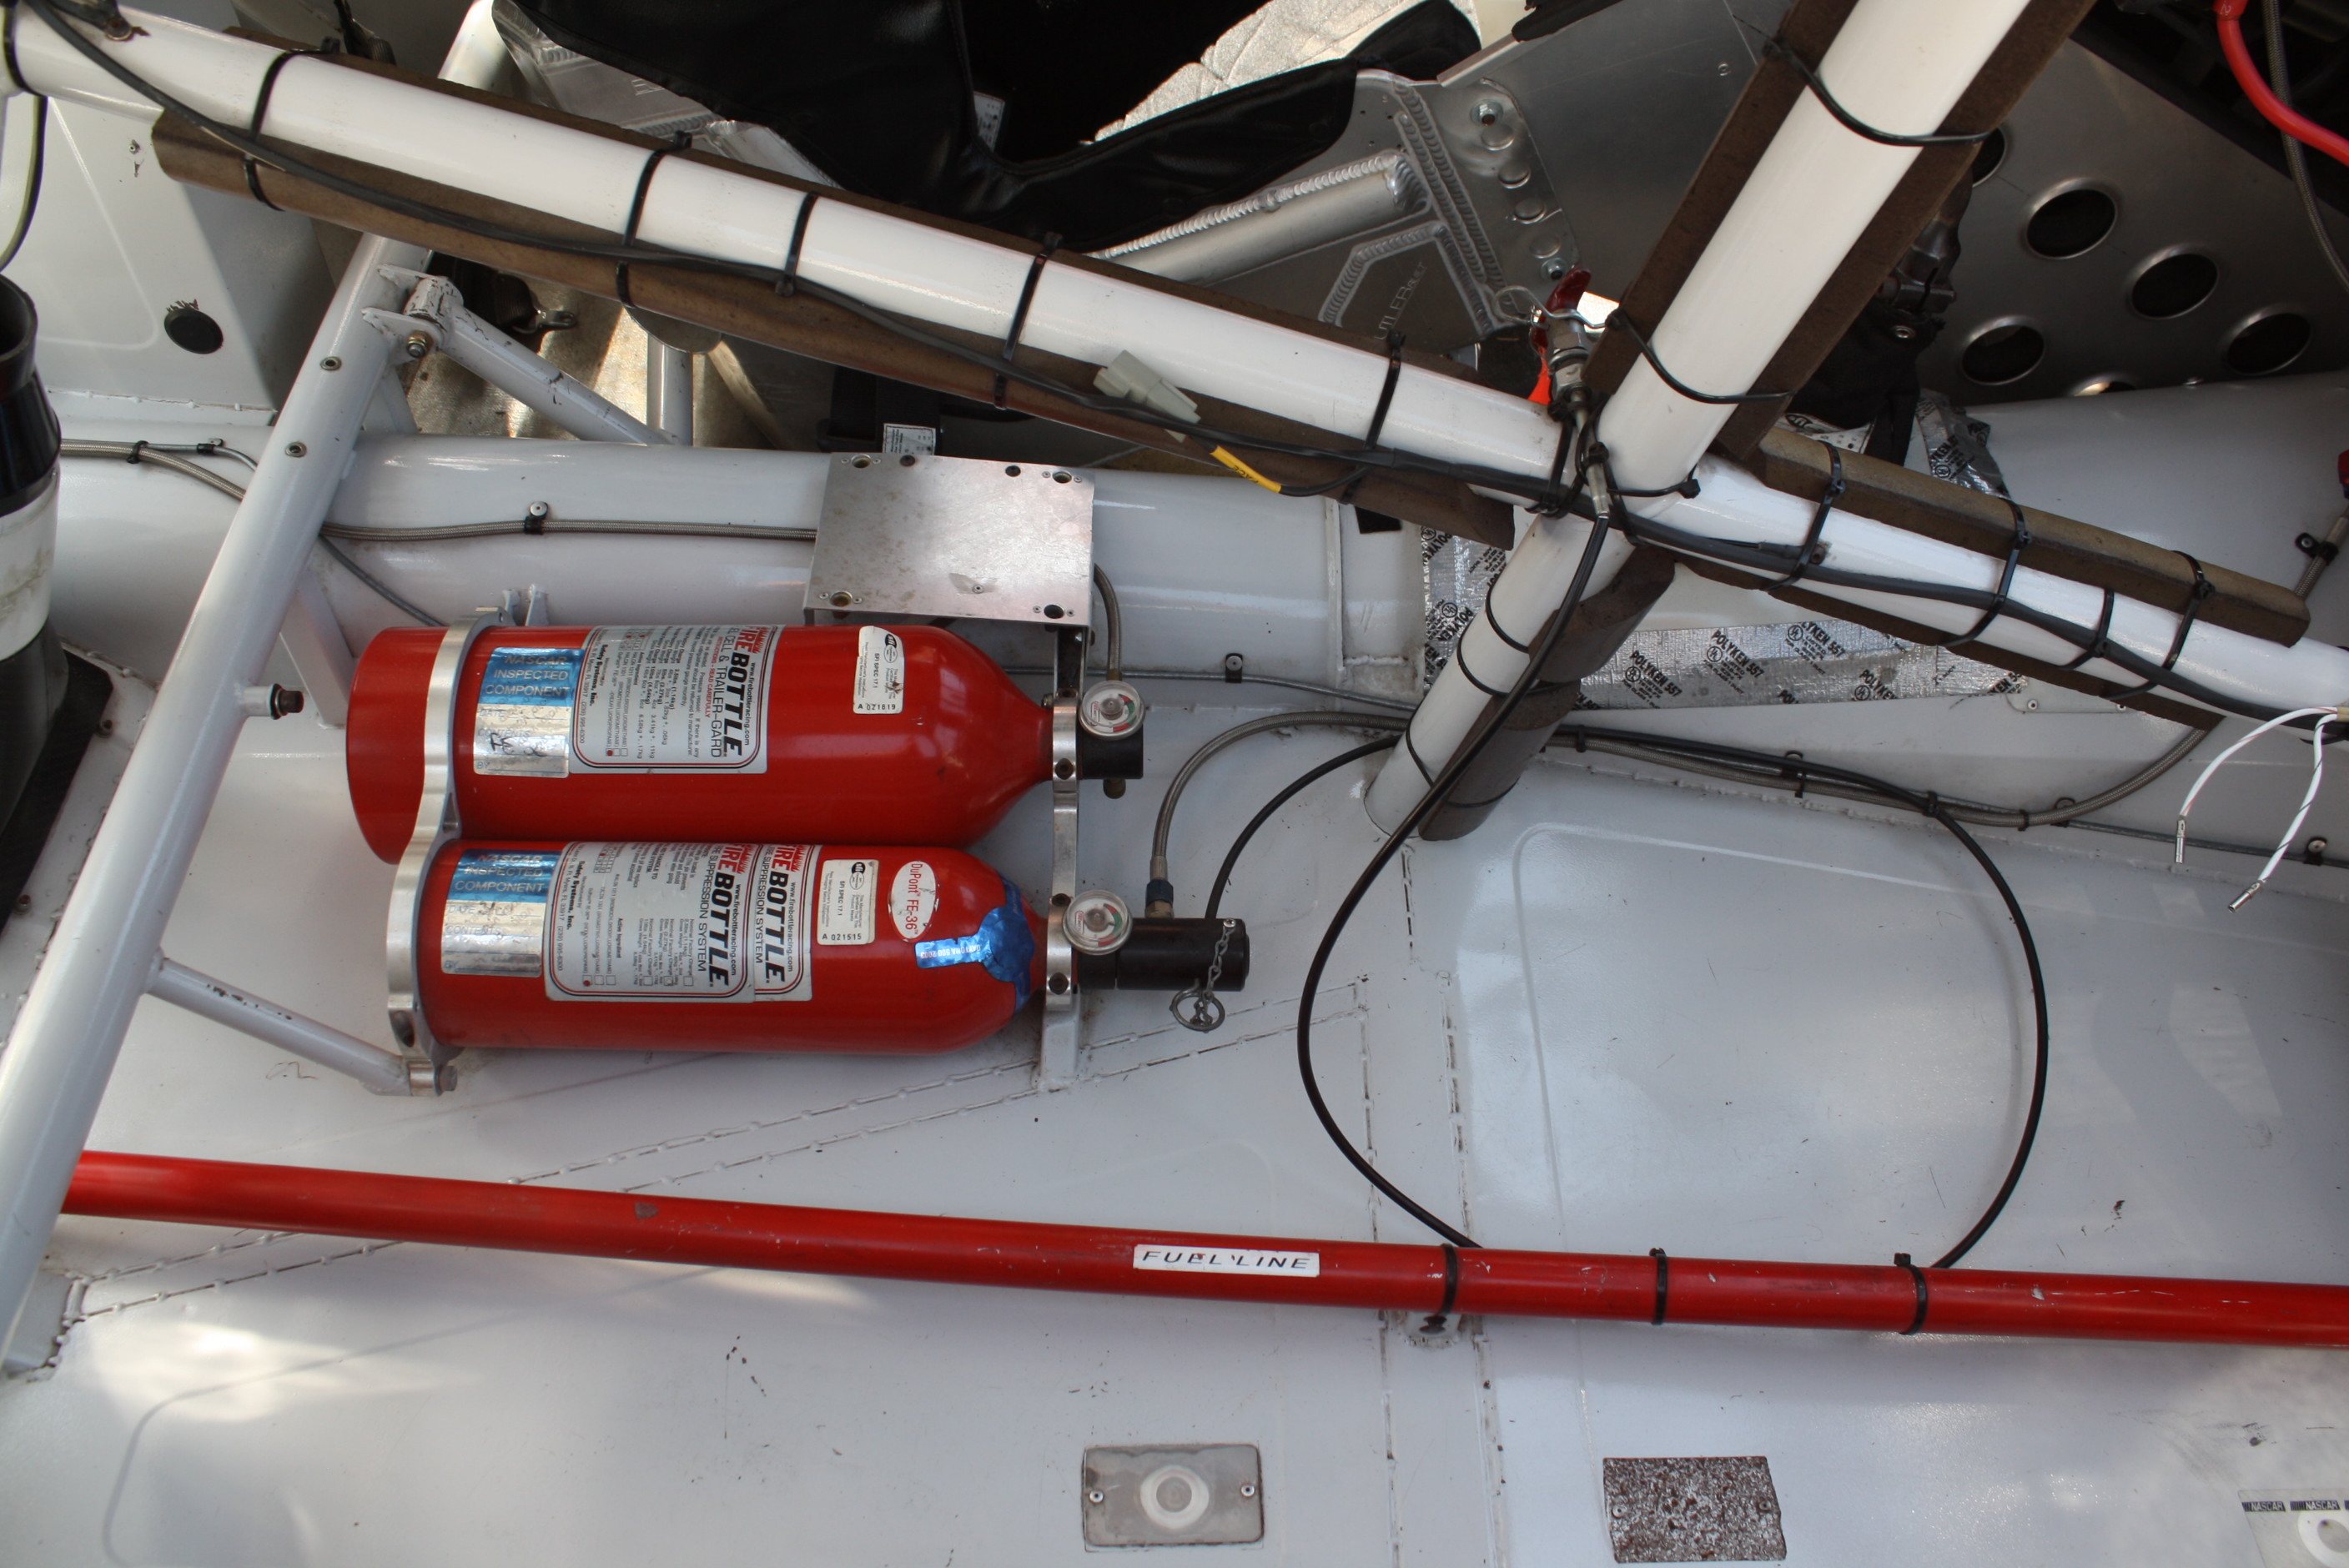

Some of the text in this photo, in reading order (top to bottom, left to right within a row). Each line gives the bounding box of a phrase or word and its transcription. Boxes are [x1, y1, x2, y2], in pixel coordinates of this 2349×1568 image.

[596, 644, 609, 661] Safety
[721, 636, 736, 652] CELL
[1711, 630, 1764, 678] POLYKEN 557
[1828, 641, 1845, 656] 557
[504, 656, 568, 665] NASCAR
[493, 669, 569, 681] INSPECTED
[591, 661, 603, 691] Systems,
[1629, 650, 1683, 697] POLYKEN 557
[485, 684, 571, 696] COMPONENT
[705, 684, 714, 718] CAREFULLY
[712, 666, 727, 757] TRAILER-GARD
[724, 652, 750, 756] BOTTLE
[744, 662, 756, 746] www.firebottleracing.com
[477, 855, 543, 863] NASCAR
[573, 861, 586, 878] Safety
[464, 867, 543, 877] INSPECTED
[455, 881, 546, 892] COMPONENT
[568, 880, 580, 912] Systems,
[699, 856, 718, 918] SUPPRESSION
[757, 857, 772, 915] SUPPRESSION
[730, 884, 741, 976] www.firebottleracing.com
[787, 882, 797, 972] www.firebottleracing.com
[697, 922, 707, 971] SYSTEM
[755, 918, 763, 963] SYSTEM
[938, 948, 950, 957] 500
[952, 945, 981, 955] DAYTONA
[1142, 1251, 1310, 1269] FUEL LINE
[2251, 1500, 2338, 1511] NASCAR NASCAR
